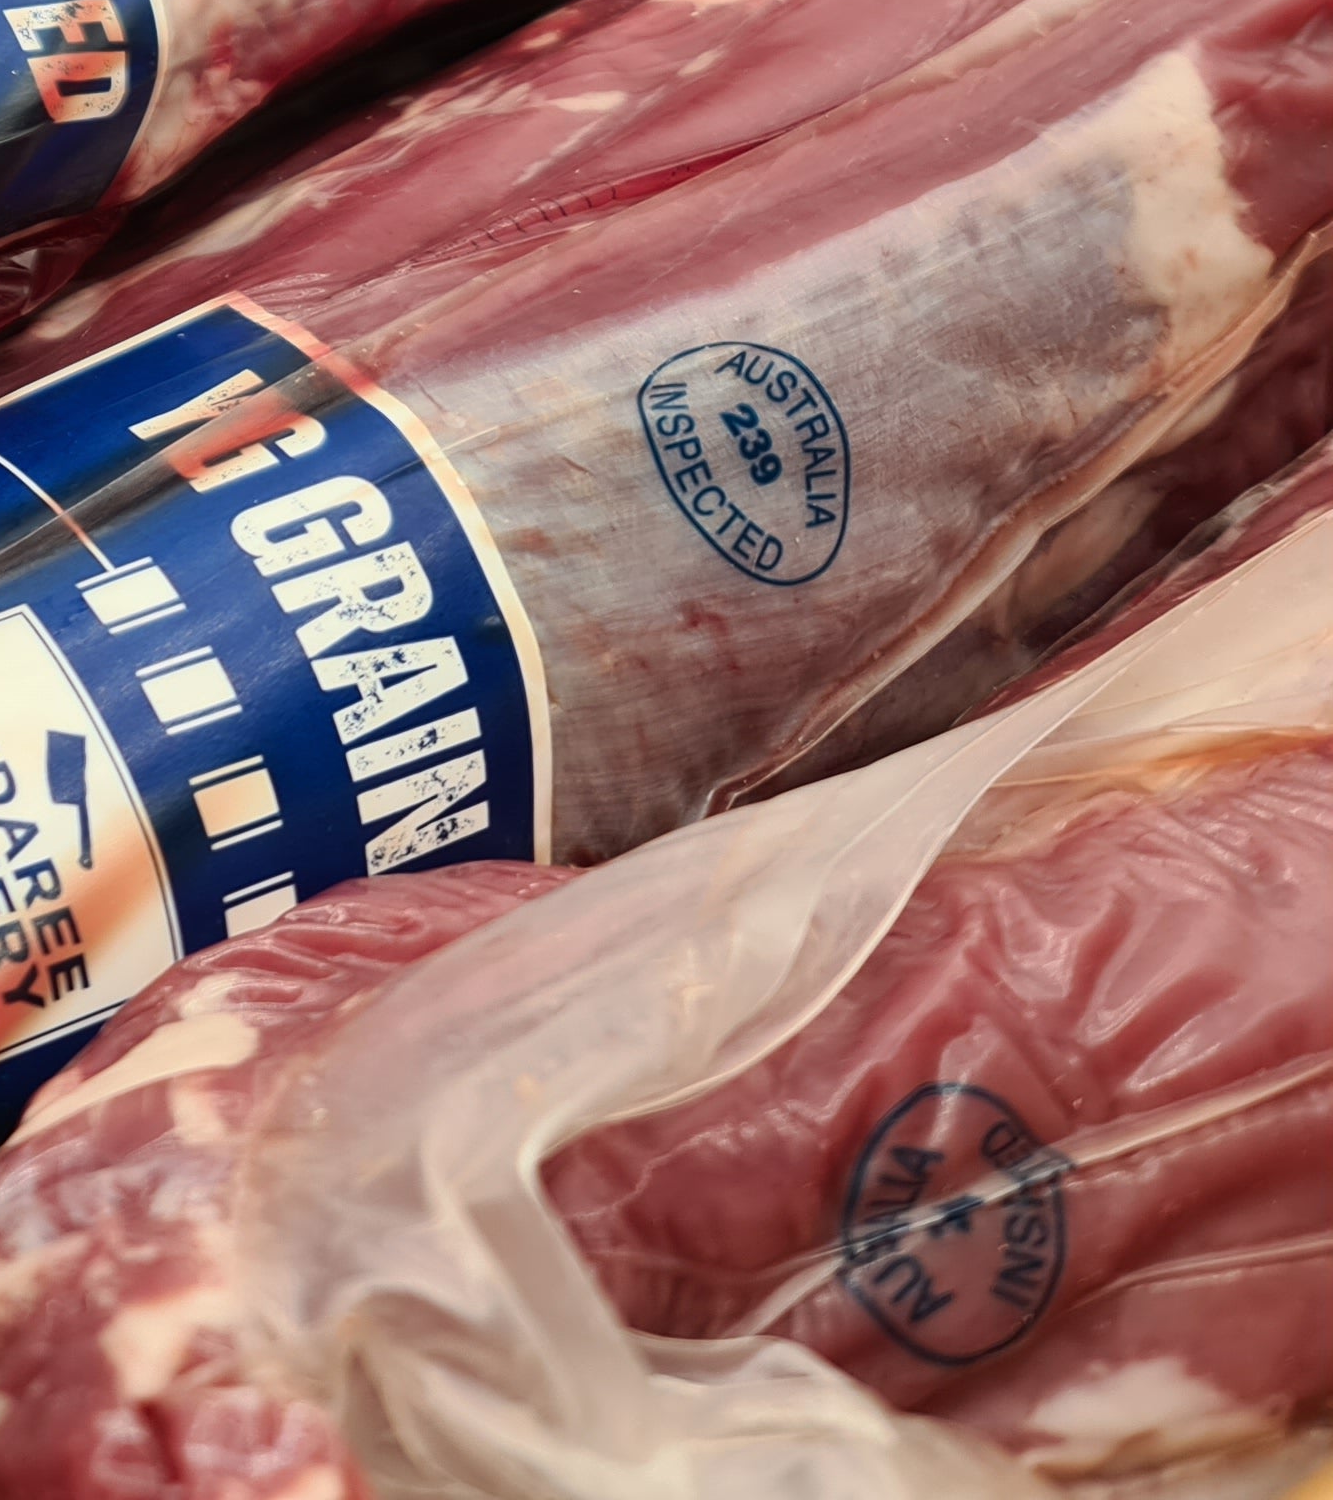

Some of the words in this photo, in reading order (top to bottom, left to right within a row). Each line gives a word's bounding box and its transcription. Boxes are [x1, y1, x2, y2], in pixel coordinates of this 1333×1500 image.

[649, 382, 784, 572] INSPECTED
[714, 350, 837, 529] AUSTRALIA
[719, 402, 783, 487] 239
[230, 474, 490, 878] GRAIN
